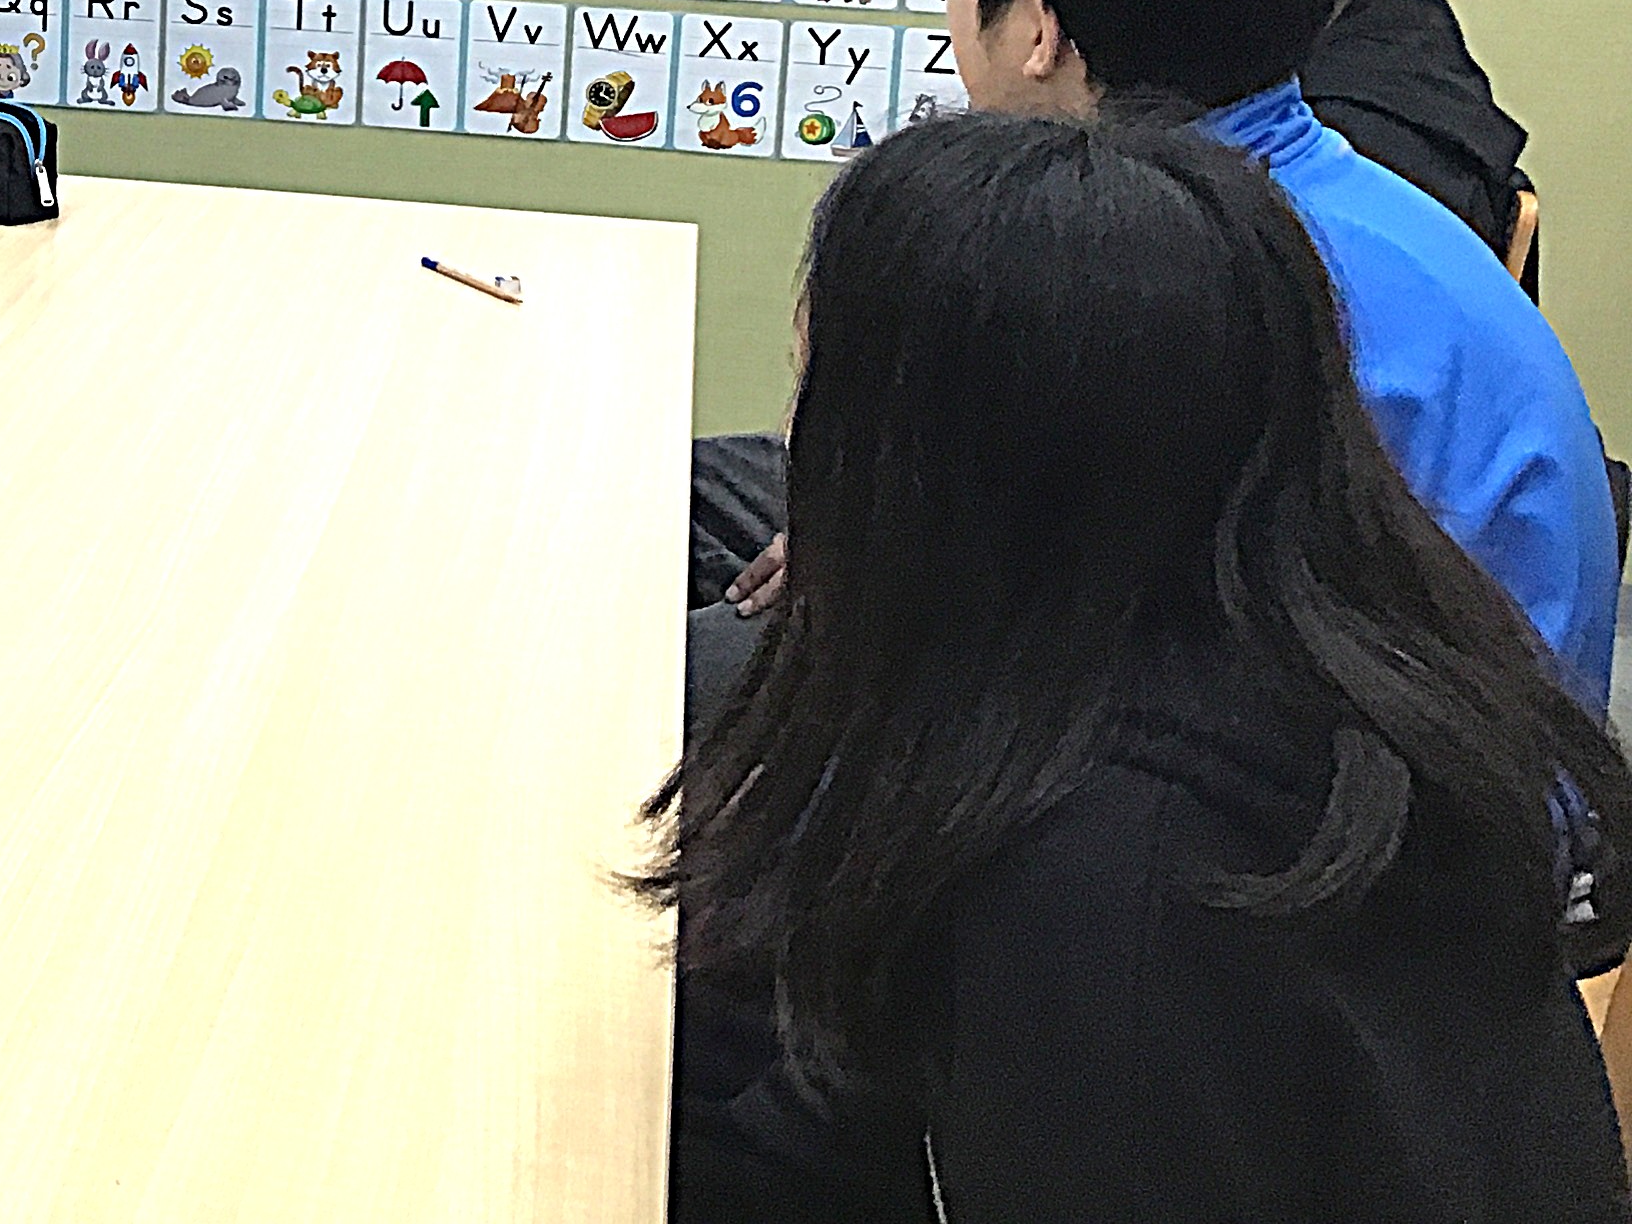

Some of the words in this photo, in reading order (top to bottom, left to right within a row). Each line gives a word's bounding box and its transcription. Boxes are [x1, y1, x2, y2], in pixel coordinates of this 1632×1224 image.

[381, 0, 444, 39] Uu
[487, 5, 543, 45] Vv
[583, 12, 667, 56] Ww
[698, 20, 762, 62] Xx
[808, 27, 869, 85] Yy
[731, 81, 764, 118] 6
